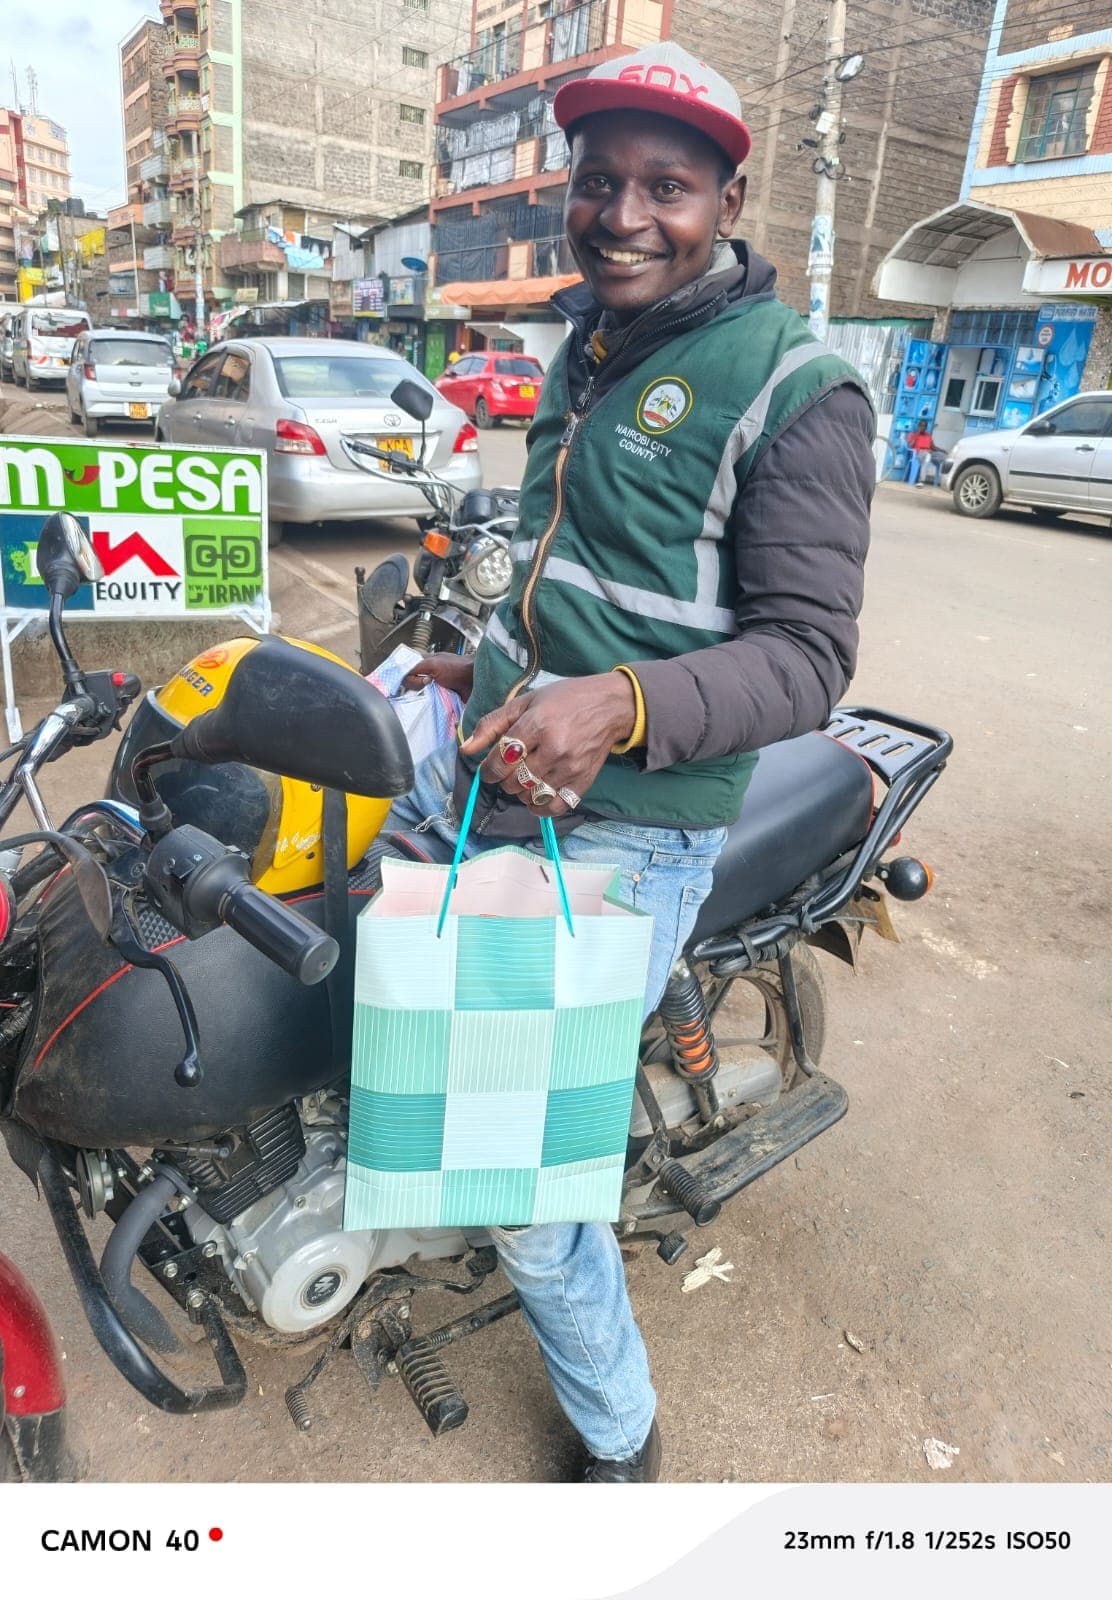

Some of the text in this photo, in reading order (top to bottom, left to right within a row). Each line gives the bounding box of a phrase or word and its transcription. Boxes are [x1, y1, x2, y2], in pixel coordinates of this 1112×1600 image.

[615, 423, 672, 457] NAIROBI CITY
[618, 438, 657, 462] COUNTY
[96, 581, 182, 601] EQUITY
